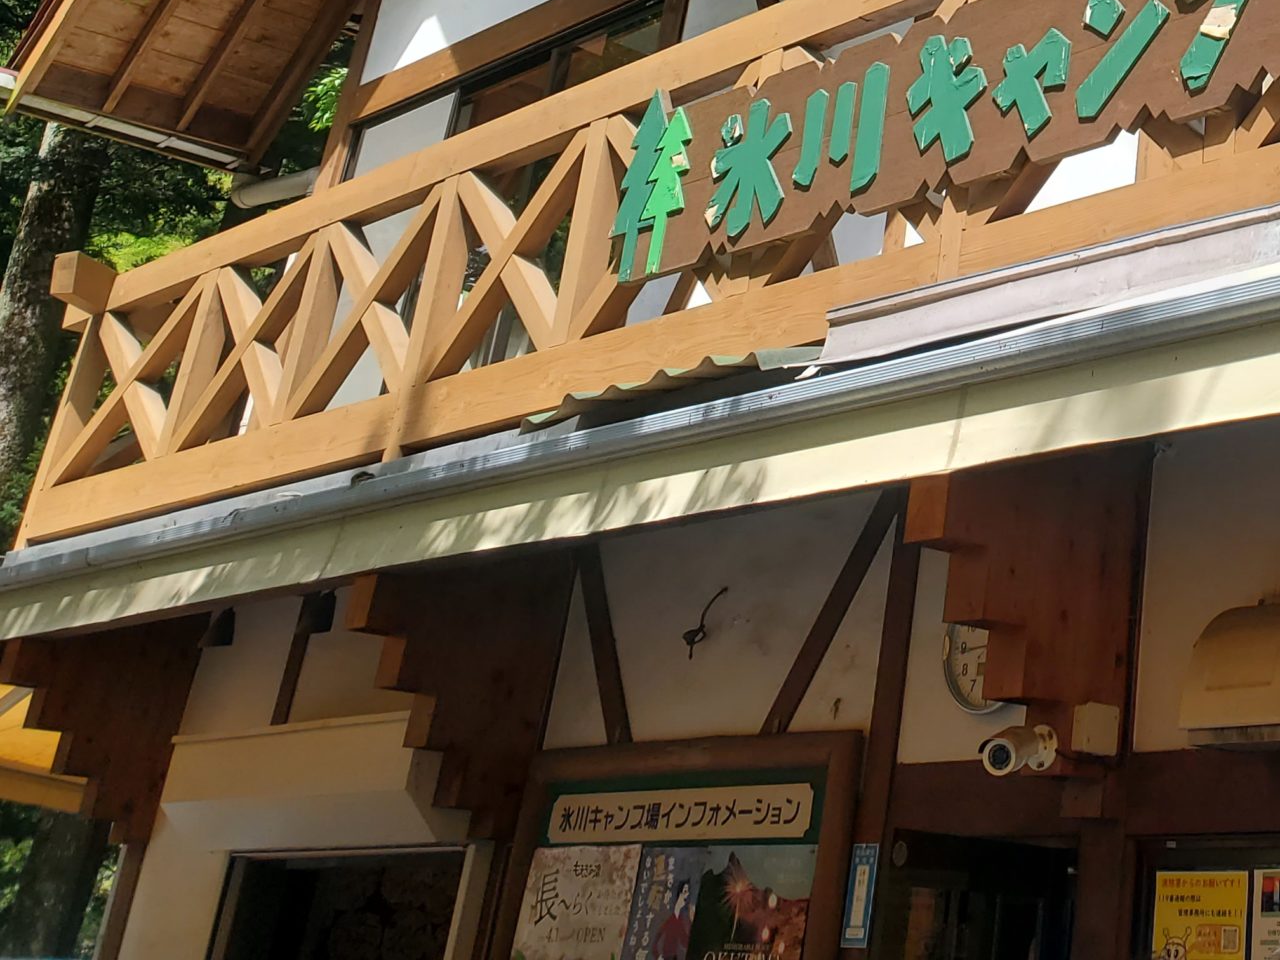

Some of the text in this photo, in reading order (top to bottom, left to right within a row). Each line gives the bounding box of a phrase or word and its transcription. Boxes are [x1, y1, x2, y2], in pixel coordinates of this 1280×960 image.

[961, 663, 968, 676] 8
[969, 679, 977, 692] 7
[559, 797, 800, 833] 氷川キャンプ場インフォメーション
